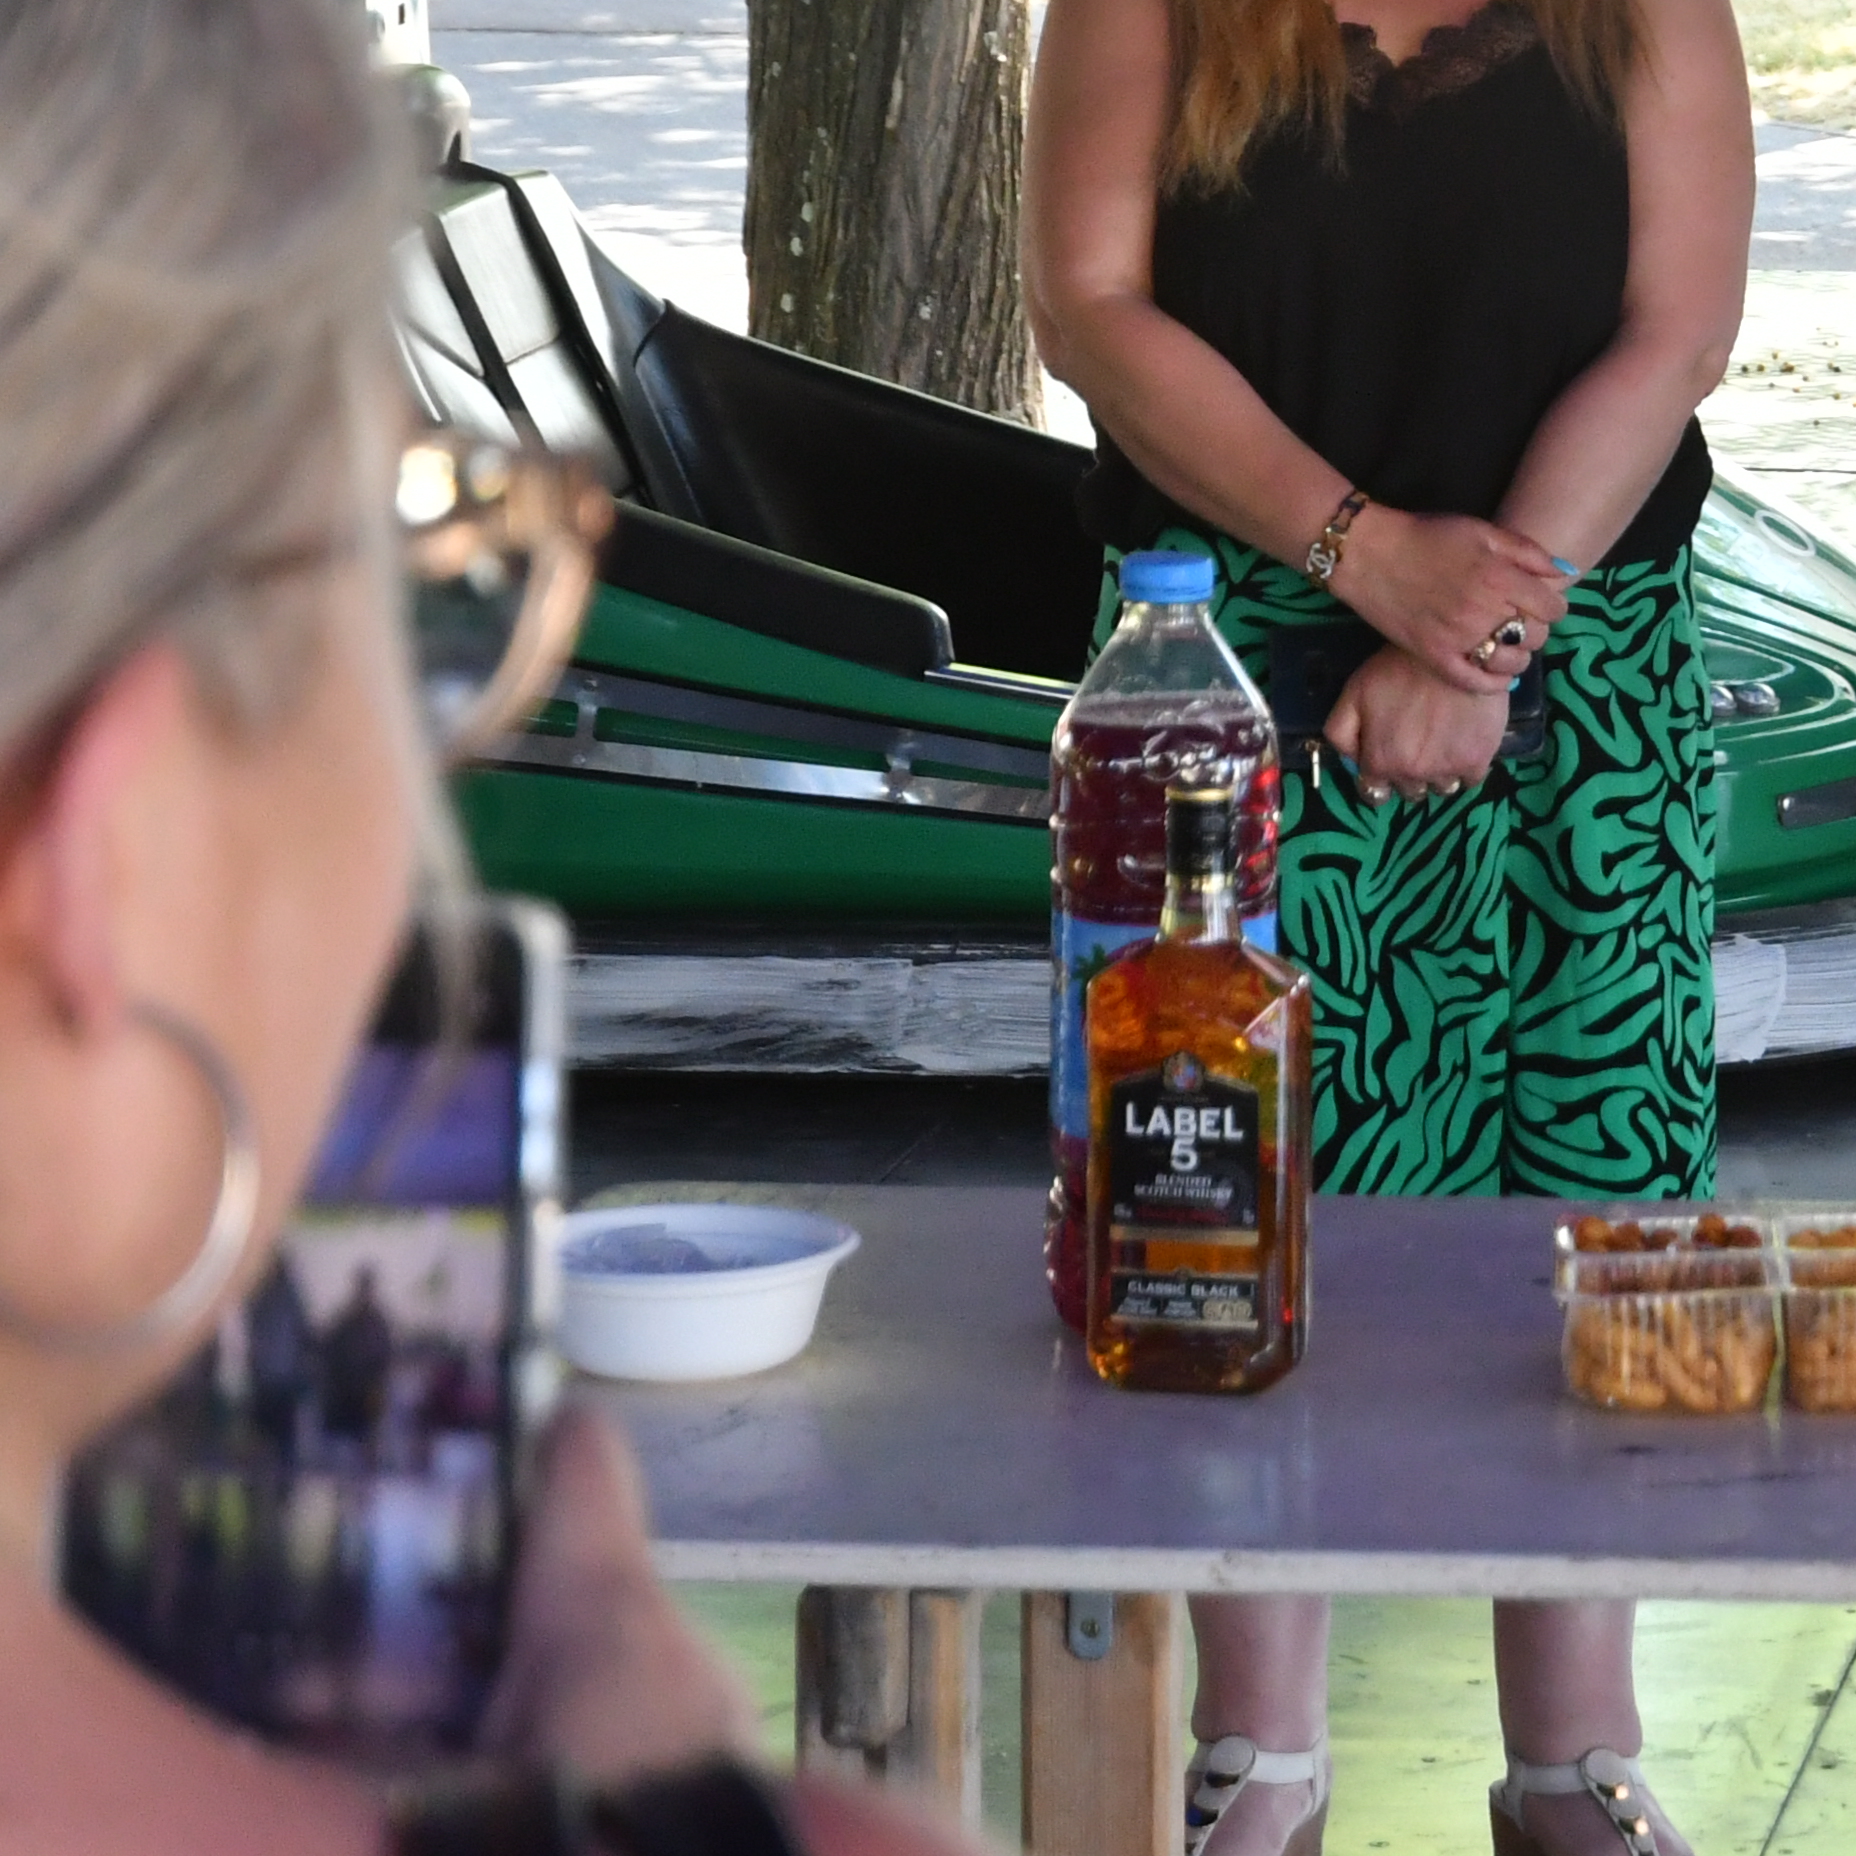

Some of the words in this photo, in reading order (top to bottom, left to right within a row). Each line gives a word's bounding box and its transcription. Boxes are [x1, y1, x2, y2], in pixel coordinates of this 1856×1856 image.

[1125, 1100, 1244, 1142] LABEL
[1169, 1135, 1199, 1172] 5
[1127, 1280, 1186, 1295] CLASSIC
[1190, 1283, 1239, 1298] BLACK
